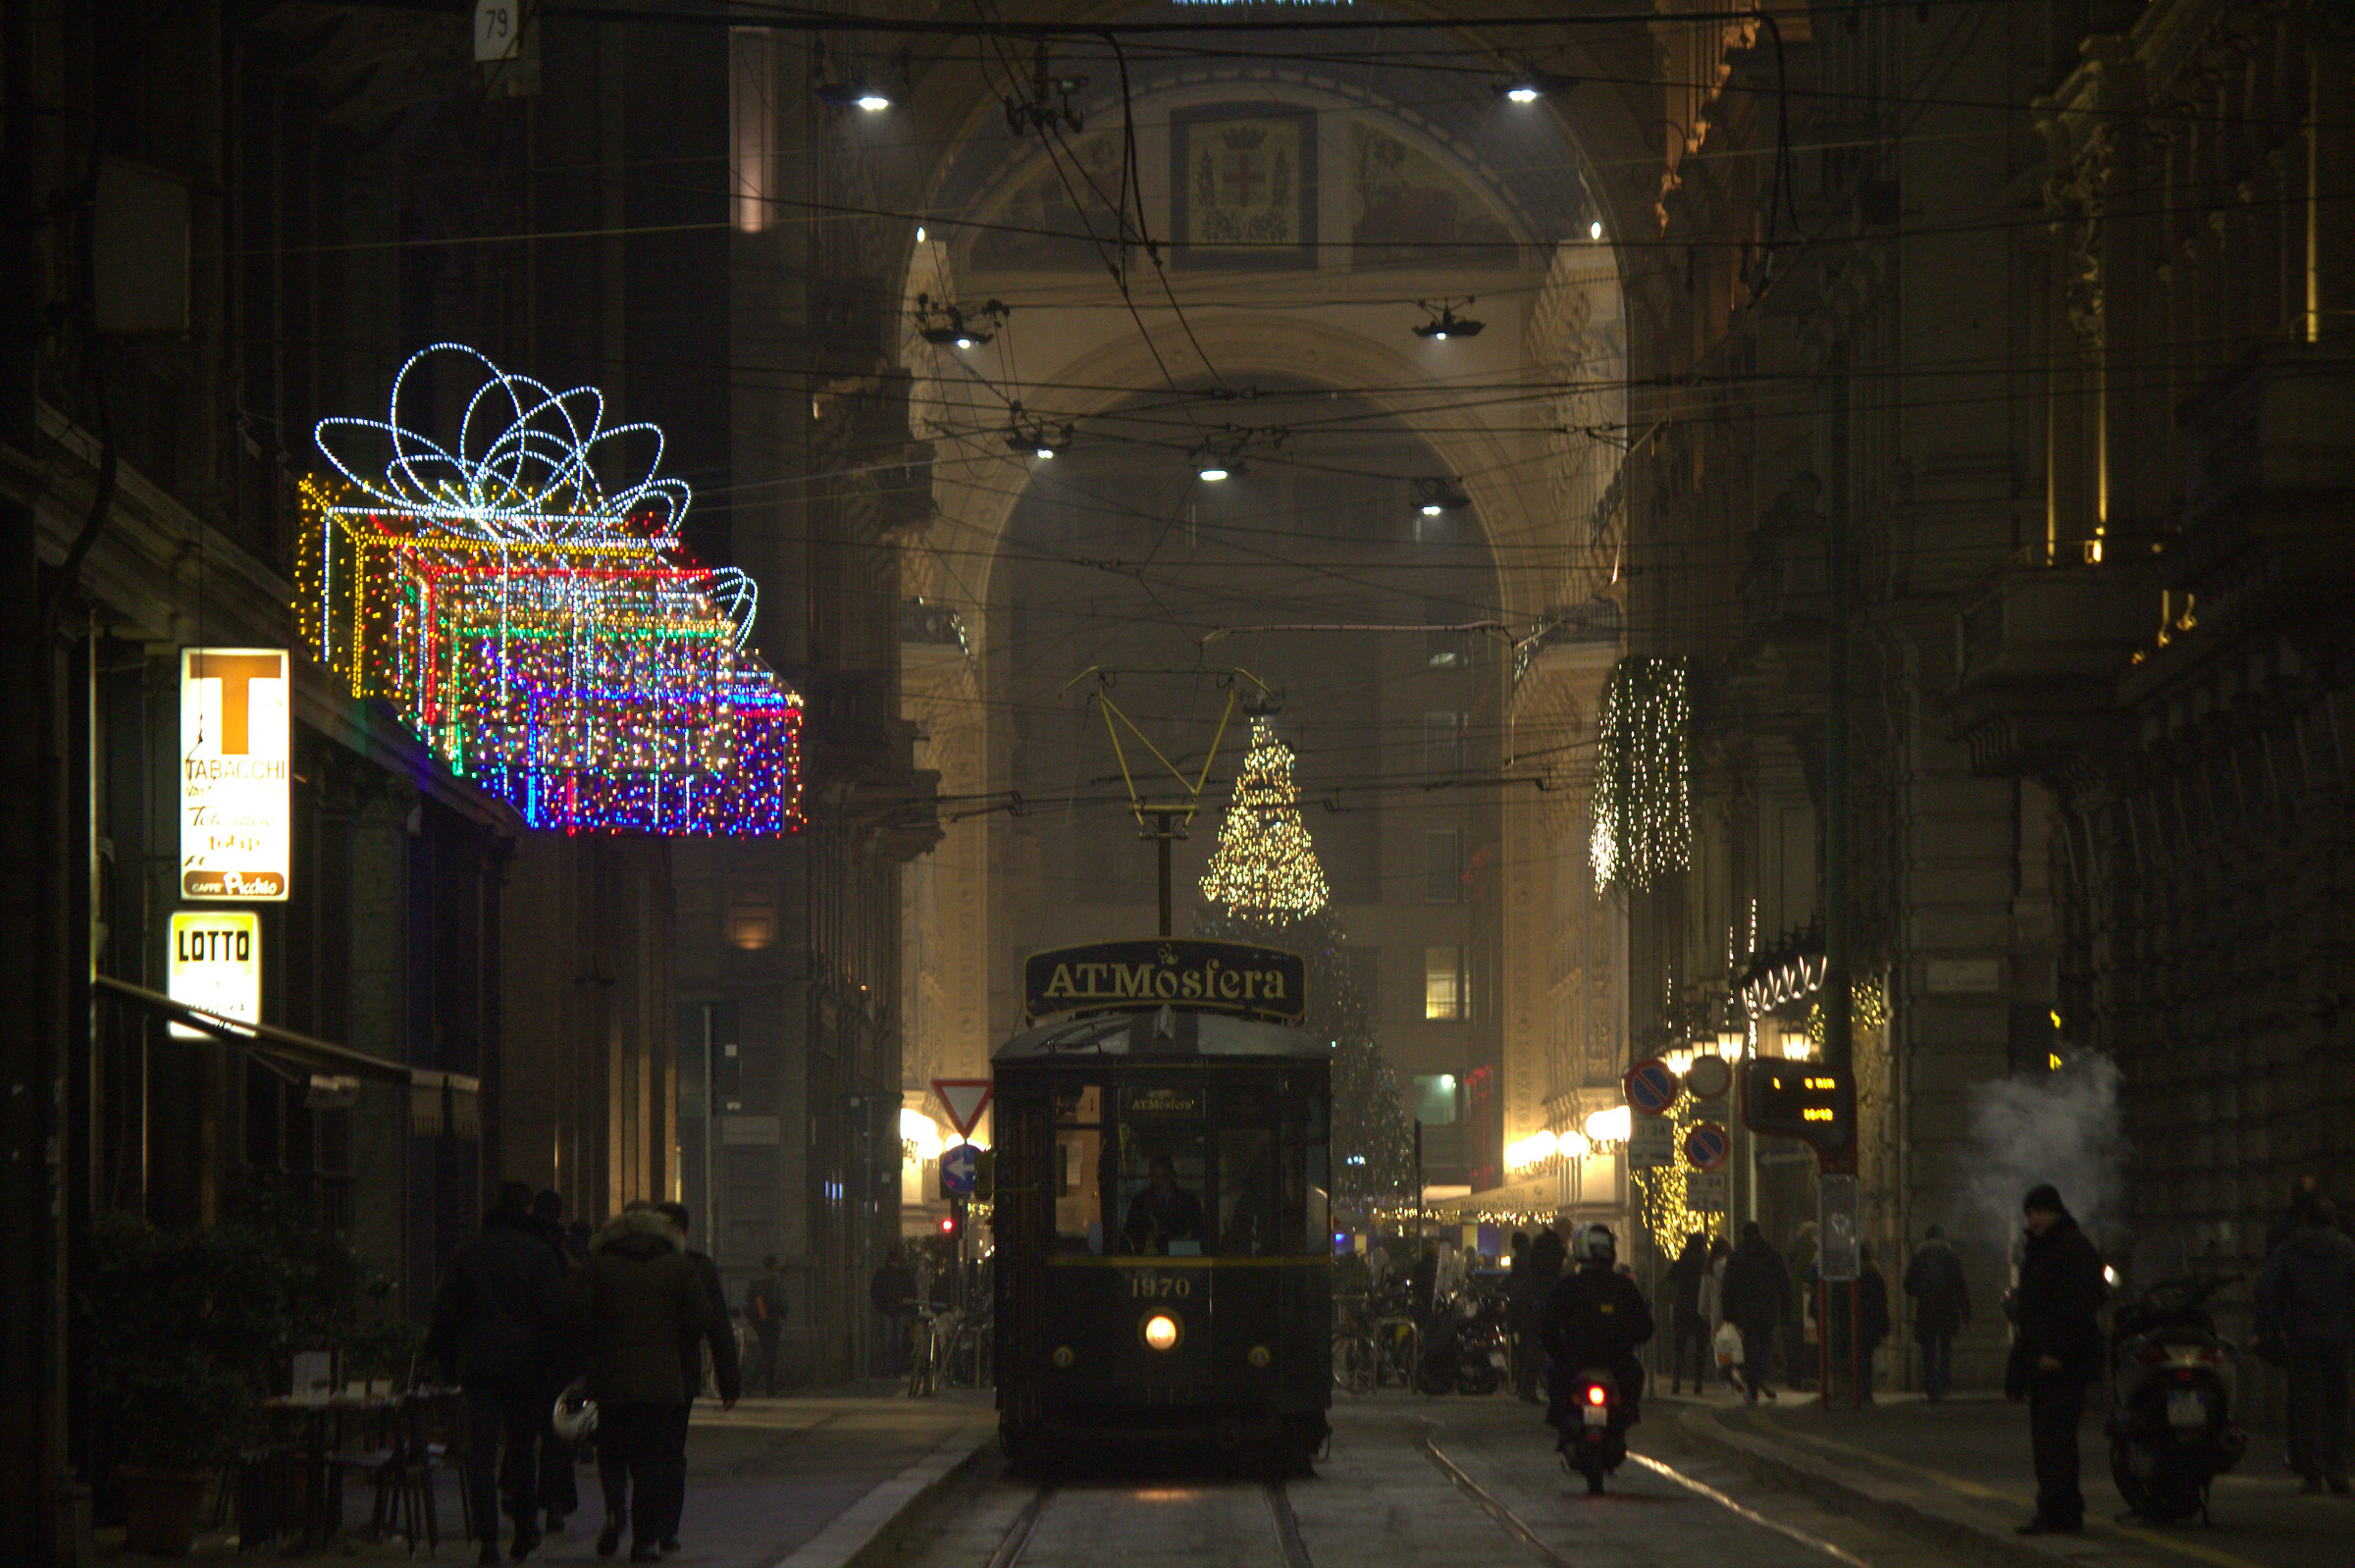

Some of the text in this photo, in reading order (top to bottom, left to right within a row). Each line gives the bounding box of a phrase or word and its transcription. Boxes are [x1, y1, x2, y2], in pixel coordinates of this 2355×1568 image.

[486, 8, 508, 39] 79
[189, 654, 282, 755] T
[185, 758, 286, 781] TABACCHI
[179, 930, 250, 962] LOTTO
[1043, 956, 1286, 1000] ATMosfera
[1131, 1278, 1190, 1298] 1970
